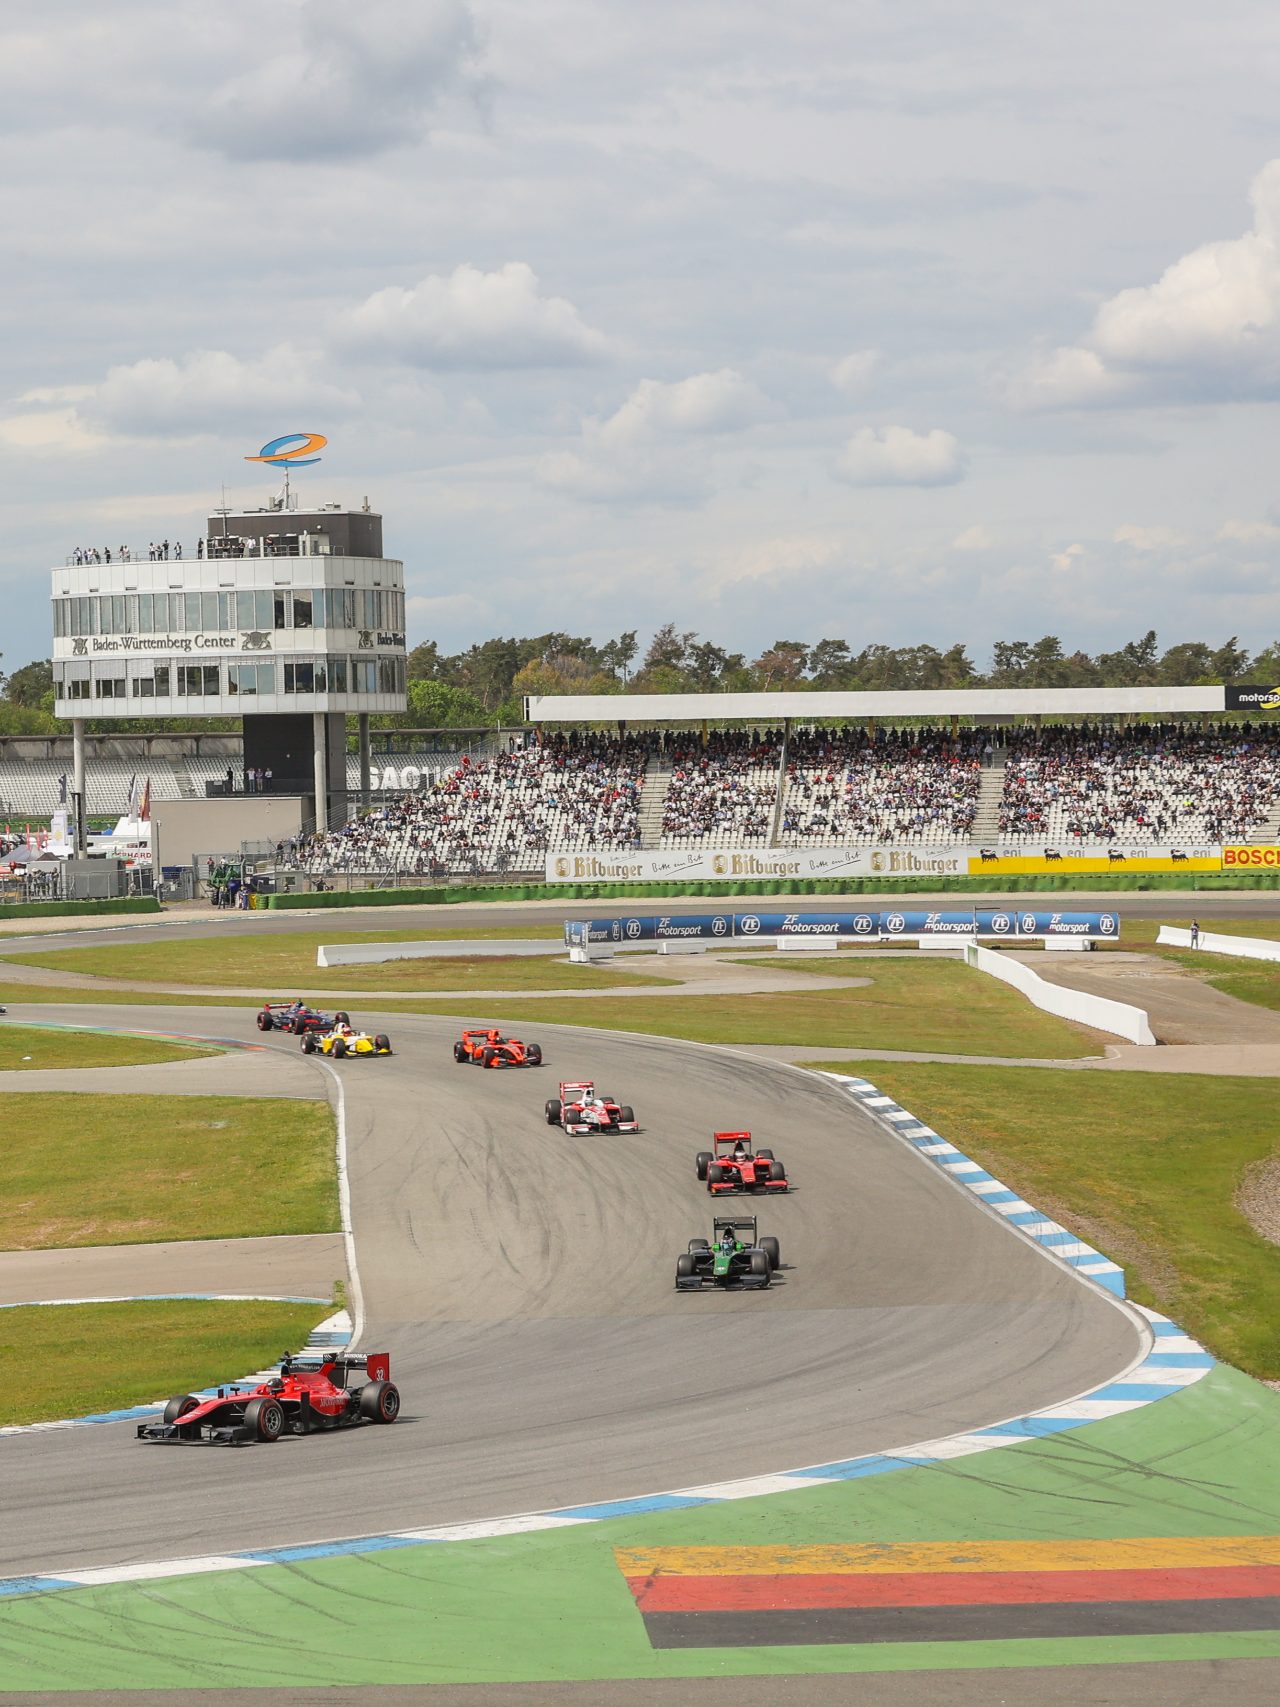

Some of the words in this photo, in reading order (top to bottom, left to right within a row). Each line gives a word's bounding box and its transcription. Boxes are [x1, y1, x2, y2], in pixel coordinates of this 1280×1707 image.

[92, 634, 192, 652] Baden-Württemberg
[194, 634, 236, 649] Center
[1003, 846, 1021, 857] eni
[1067, 846, 1086, 858] eni
[1130, 847, 1148, 858] eni
[1193, 846, 1211, 858] eni
[574, 856, 643, 879] Bitburger
[731, 854, 801, 877] Bitburger
[889, 851, 959, 874] Bitburger
[658, 918, 670, 928] ZF
[783, 914, 799, 924] ZF
[926, 914, 942, 923] ZF
[1051, 914, 1062, 923] ZF
[657, 926, 701, 937] motorsport
[782, 923, 840, 934] motorsport
[924, 922, 979, 933] motorsport
[1049, 922, 1090, 934] motorsport
[376, 1368, 385, 1381] 32
